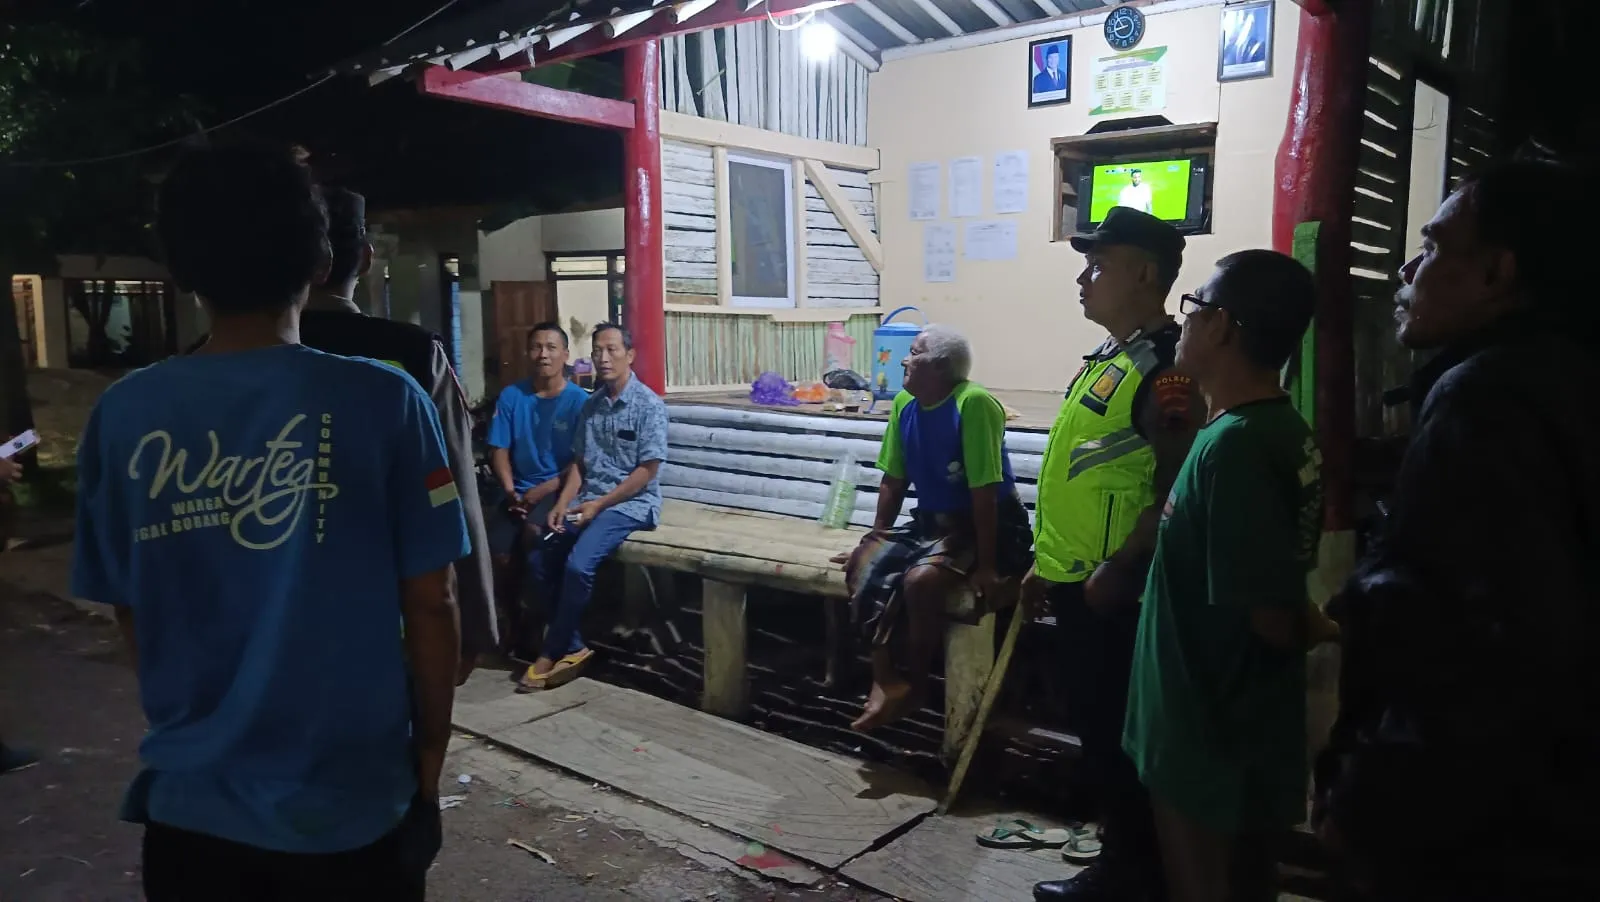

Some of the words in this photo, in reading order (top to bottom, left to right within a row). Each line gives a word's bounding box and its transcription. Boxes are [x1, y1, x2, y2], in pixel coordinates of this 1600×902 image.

[128, 414, 339, 549] Warteg
[171, 495, 225, 516] WARGA
[315, 412, 332, 544] COMMUNITY
